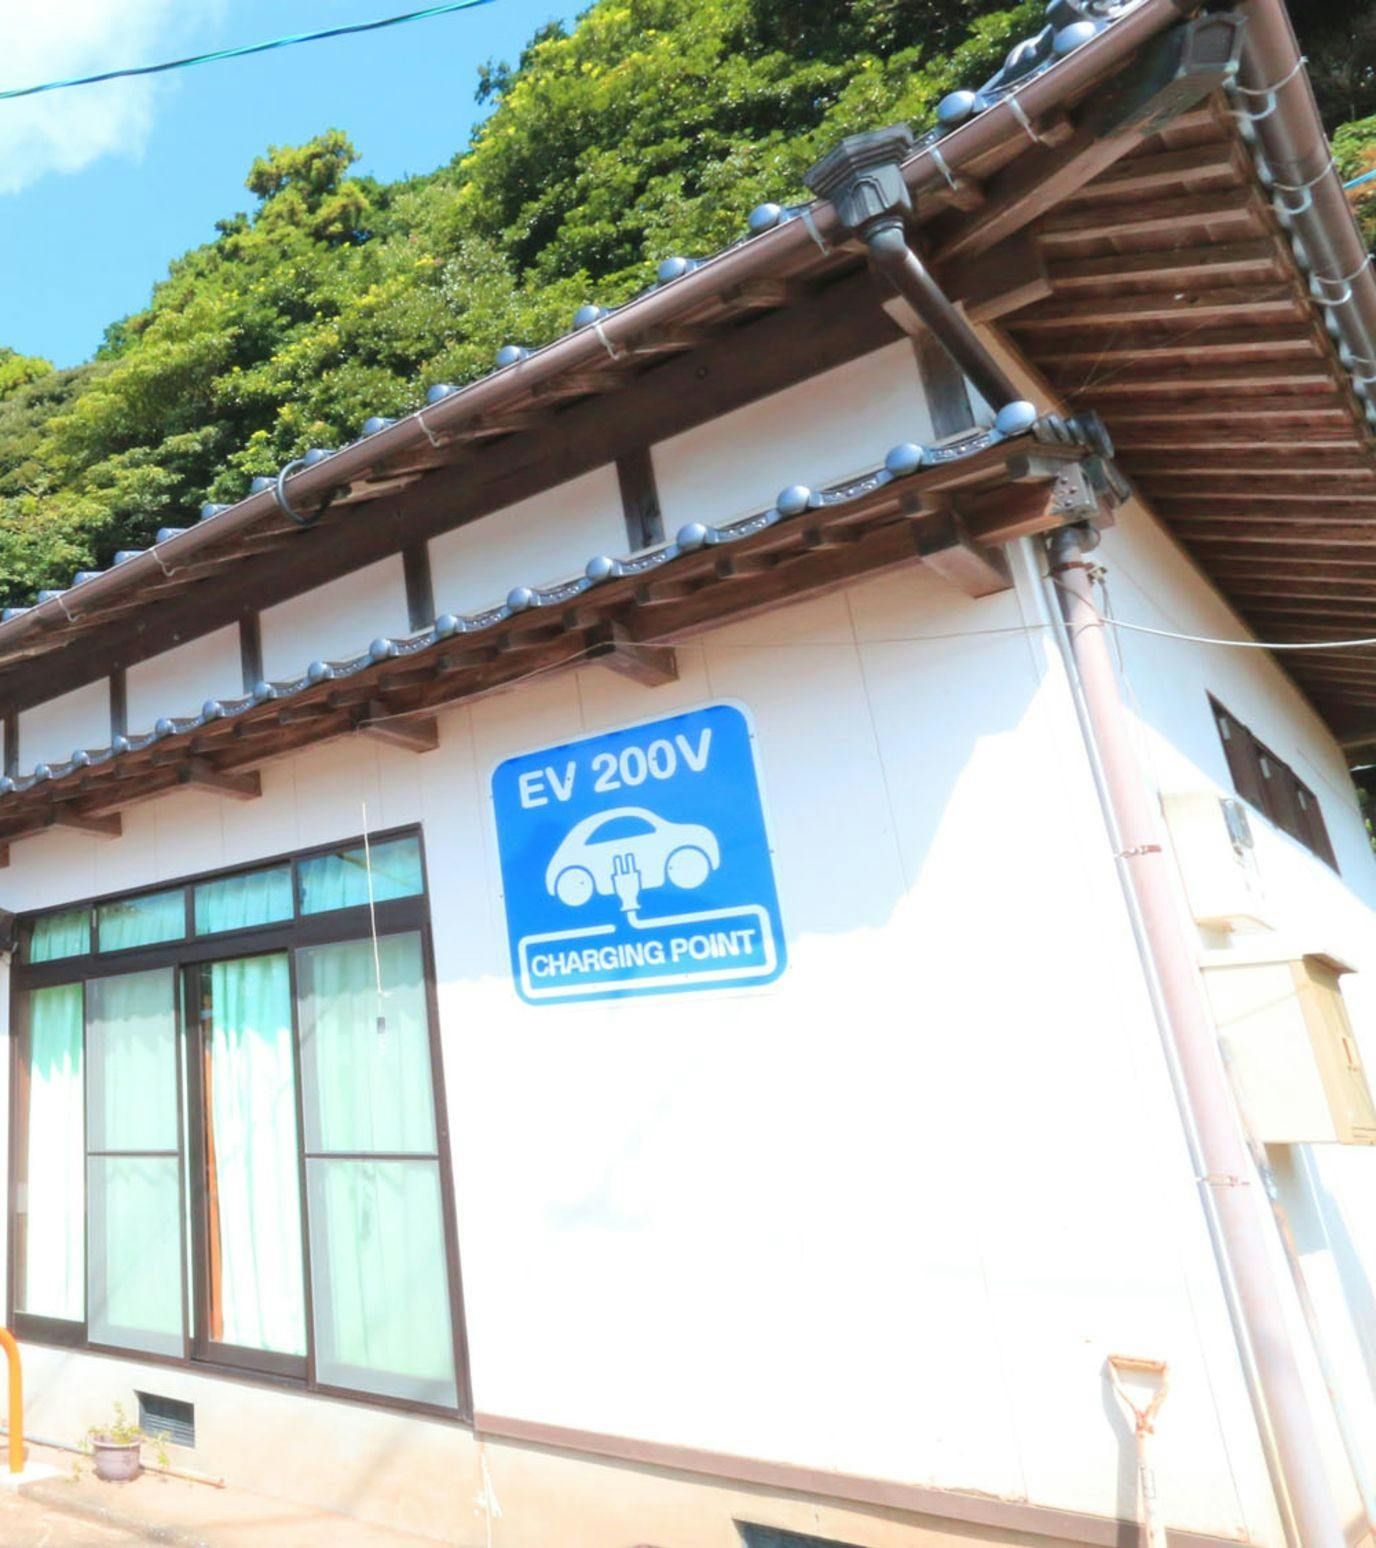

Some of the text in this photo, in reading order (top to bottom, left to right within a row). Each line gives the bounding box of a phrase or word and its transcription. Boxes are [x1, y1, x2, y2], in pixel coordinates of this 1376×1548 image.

[519, 728, 712, 809] EV 200V
[531, 929, 756, 977] CHARGING POINT
